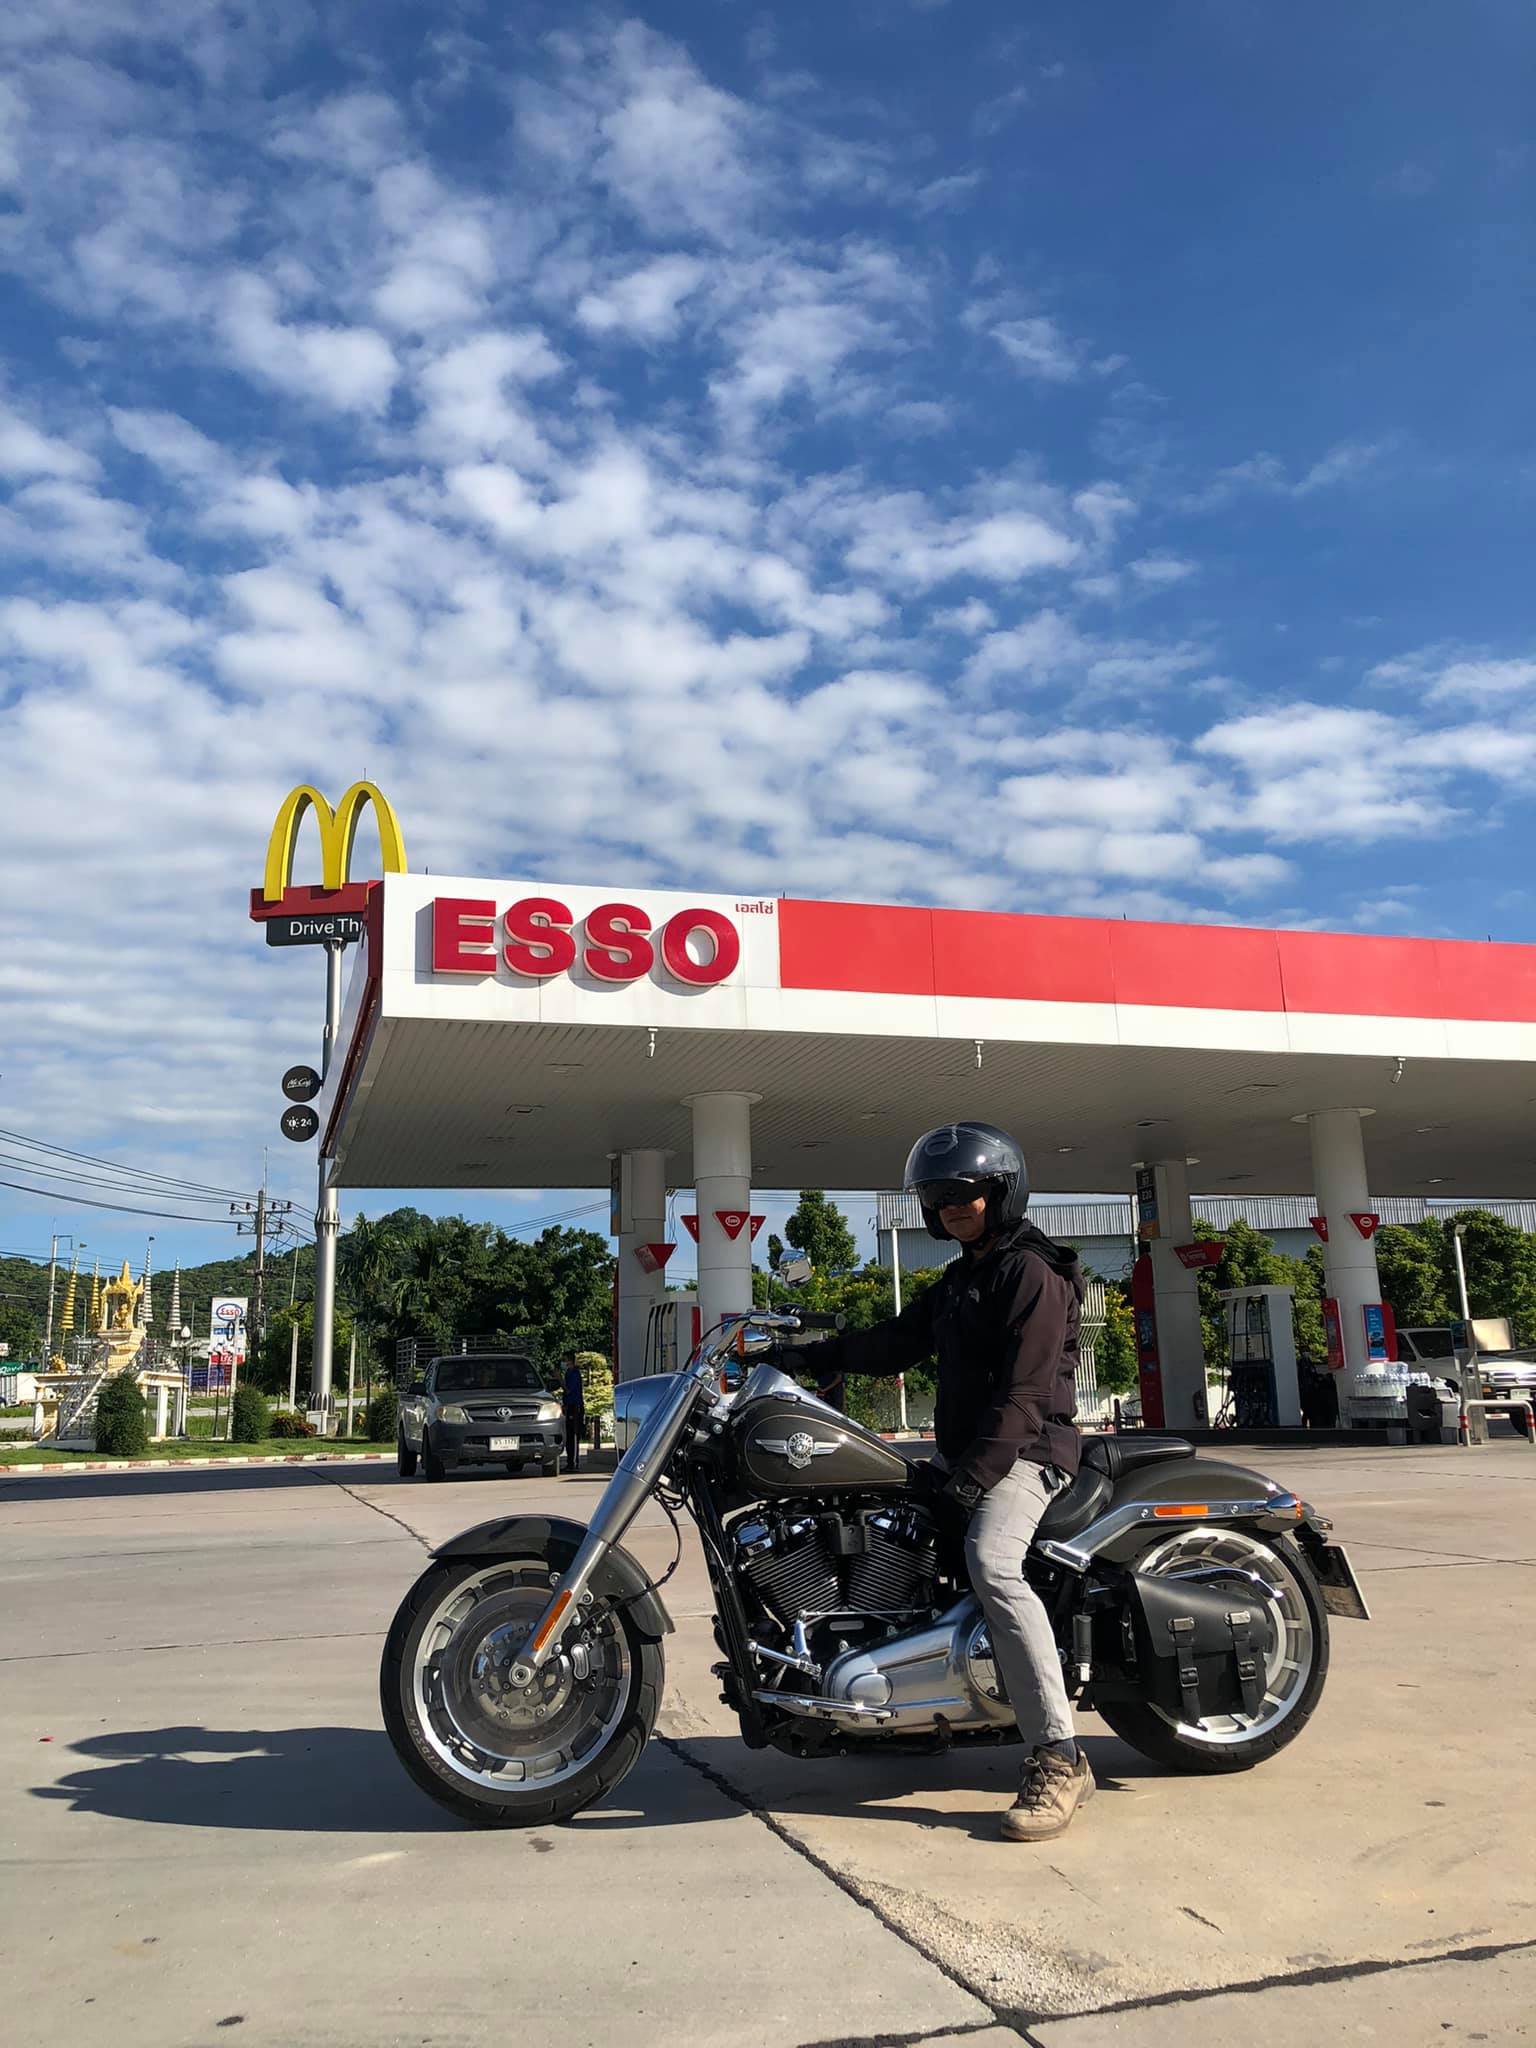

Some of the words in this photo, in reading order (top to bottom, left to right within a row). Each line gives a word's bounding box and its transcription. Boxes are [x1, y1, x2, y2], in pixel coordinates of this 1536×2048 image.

[735, 901, 774, 915] เอสโซ่
[290, 920, 335, 936] Drive
[432, 896, 741, 987] ESSO
[751, 1222, 757, 1231] 2
